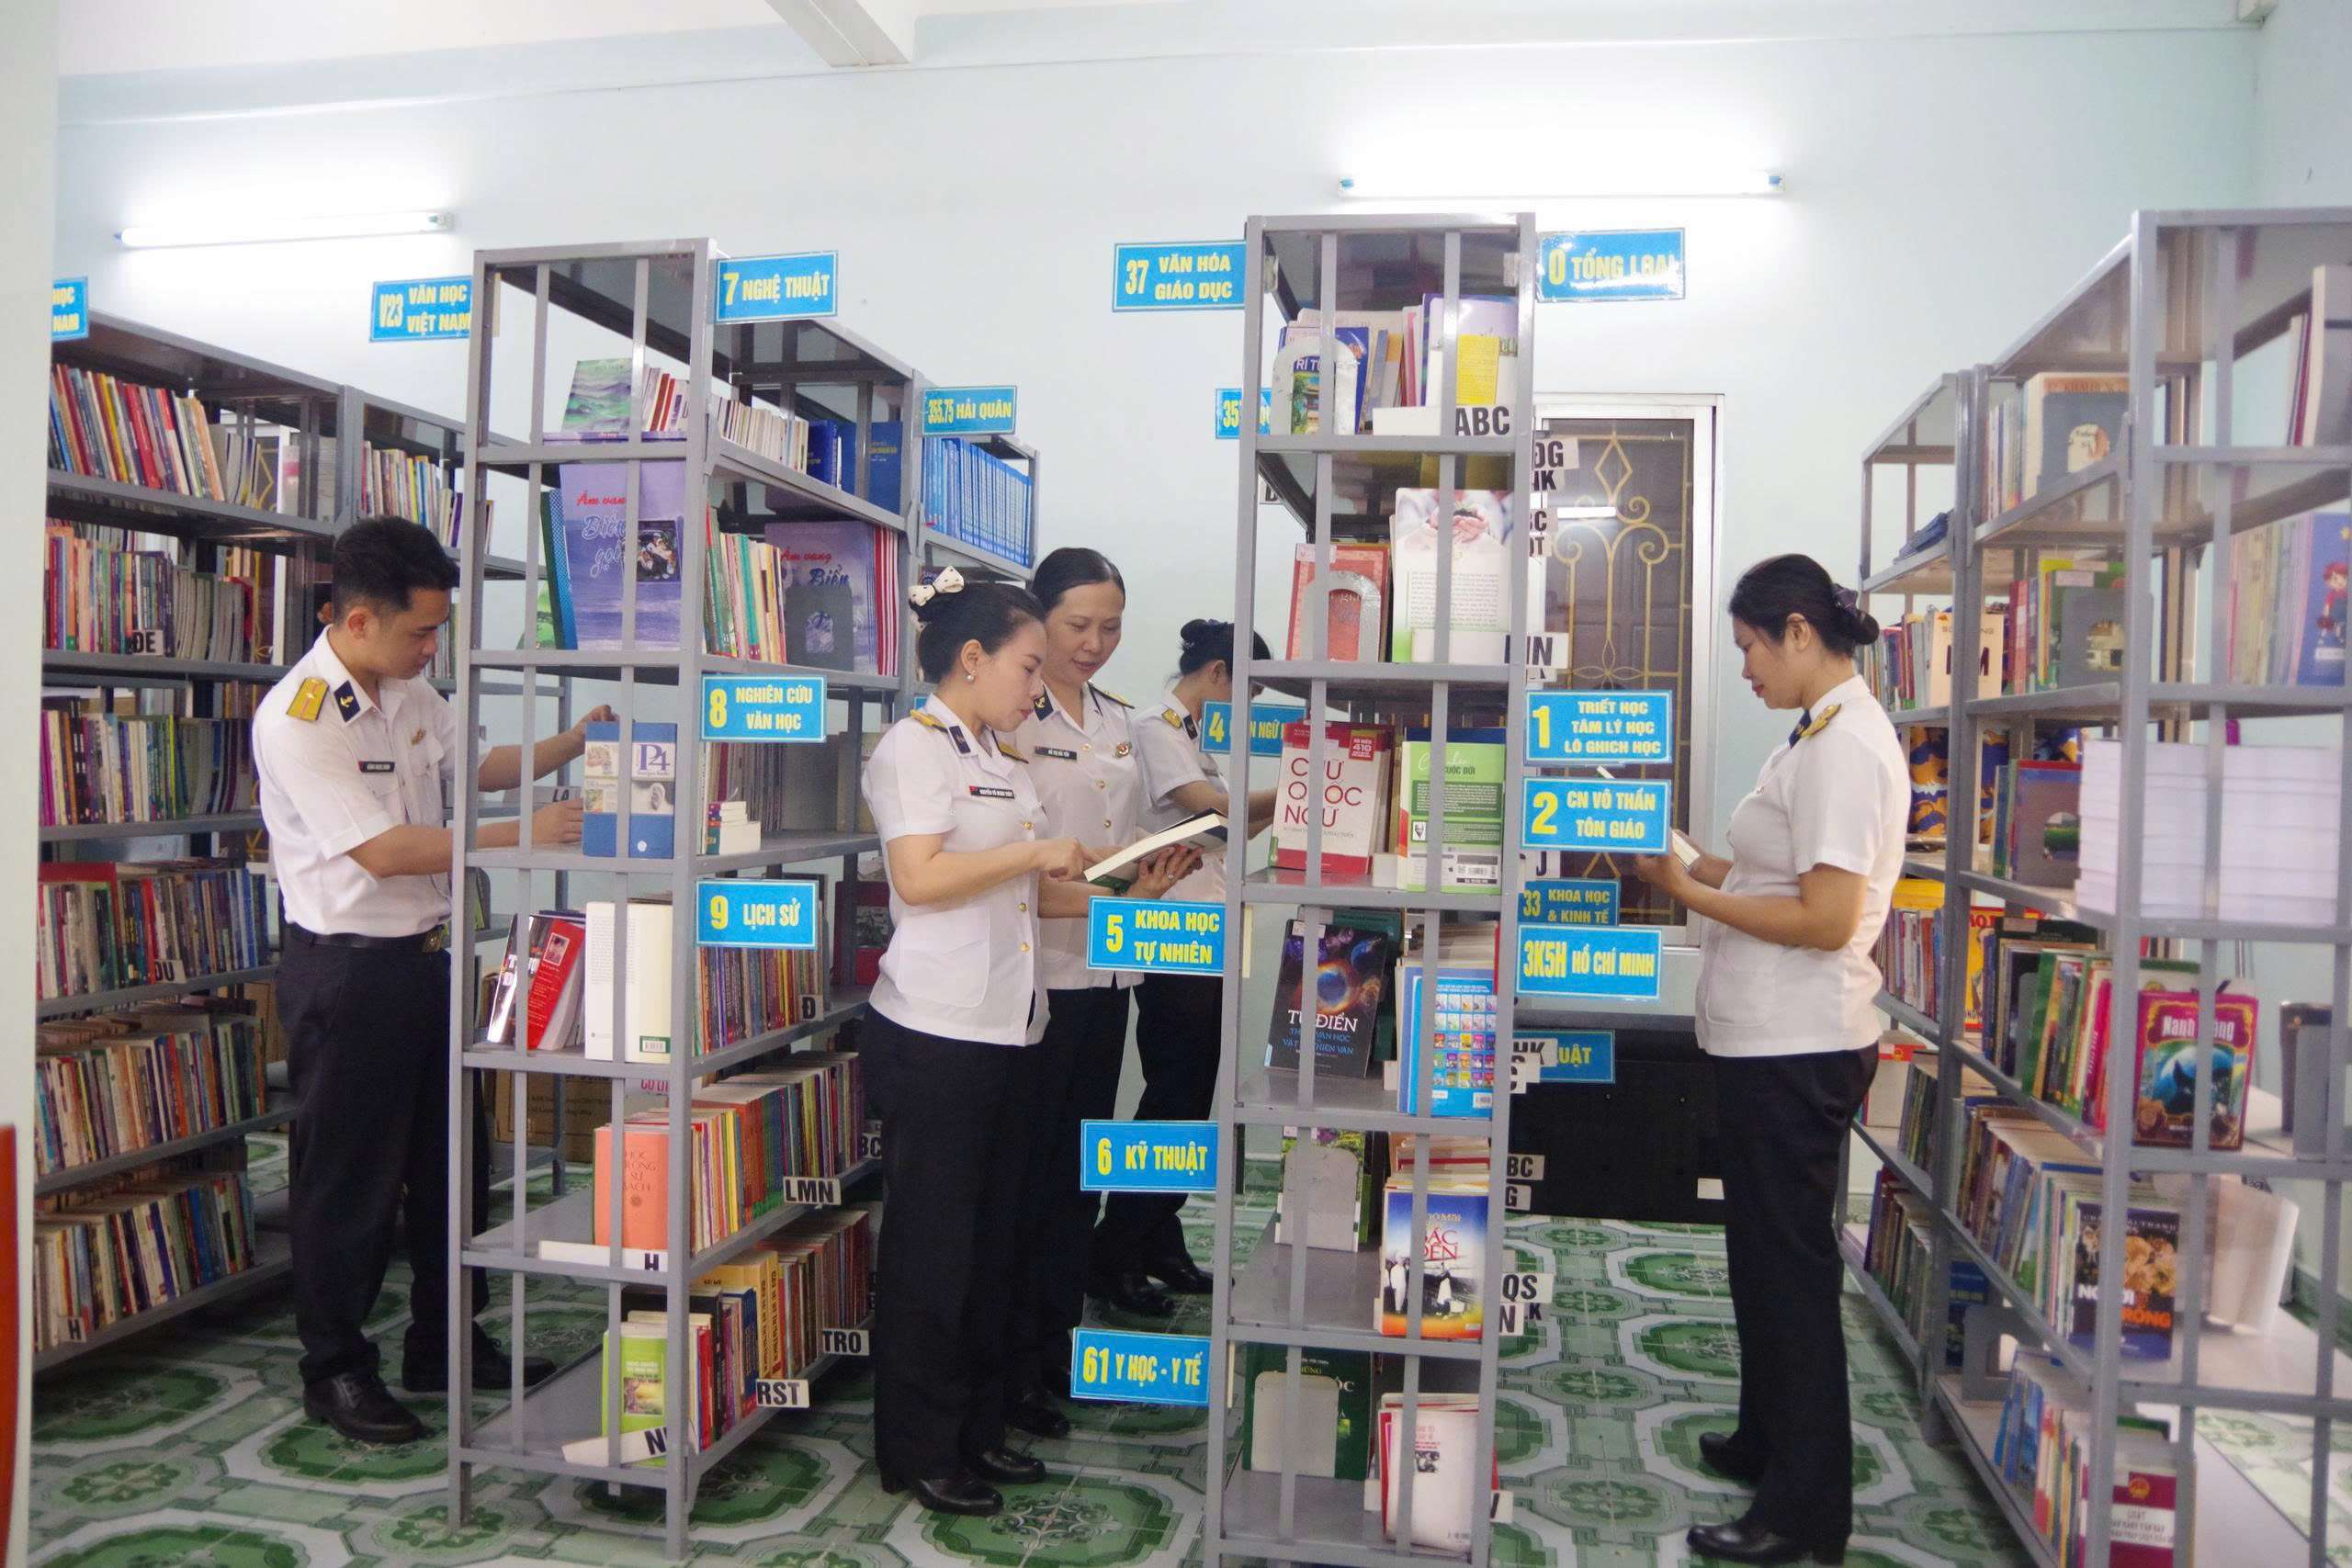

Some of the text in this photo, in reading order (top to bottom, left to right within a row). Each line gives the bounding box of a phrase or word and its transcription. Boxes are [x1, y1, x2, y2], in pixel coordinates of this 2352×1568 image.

[1159, 253, 1231, 273] VĂN HÓA
[1572, 247, 1623, 279] TỔNG
[724, 271, 830, 305] 7 NGHỆ THUẬT
[1125, 260, 1148, 295] 37
[1155, 279, 1232, 301] GIÁO DỤC
[409, 285, 467, 306] VĂN HỌC
[379, 293, 404, 328] V23
[407, 312, 436, 335] VIỆT
[956, 398, 976, 419] HẢI
[979, 399, 1012, 420] QUÂN
[1455, 406, 1510, 436] ABC
[709, 688, 729, 728] 8
[736, 684, 813, 705] NGHIÊN CỨU
[1577, 699, 1649, 717] TRIẾT HỌC
[746, 710, 802, 734] VĂN HỌC
[1208, 711, 1225, 743] 4
[1532, 705, 1551, 749] 1
[1572, 718, 1656, 737] TÂM LÝ HỌC
[1564, 738, 1583, 753] LÔ
[1632, 740, 1662, 757] HỌC
[1566, 791, 1589, 809] CN
[1592, 787, 1611, 809] VÔ
[1532, 792, 1558, 834] 2
[1576, 817, 1645, 839] TÔN GIÁO
[1522, 889, 1542, 917] 33
[1548, 889, 1611, 905] KHOA HỌC
[710, 895, 729, 930] 9
[743, 897, 802, 930] LỊCH SỬ
[1136, 909, 1220, 936] KHOA HỌC
[1547, 908, 1610, 924] & KINH TẾ
[1106, 914, 1125, 953] 5
[1134, 941, 1213, 965] TỰ NHIÊN
[1522, 940, 1567, 977] 3K5H
[1593, 946, 1616, 975] CHÍ
[1618, 952, 1655, 976] MINH
[1097, 1137, 1113, 1175] 6
[1125, 1141, 1208, 1176] KỸ THUẬT
[785, 1179, 835, 1203] LMN
[1502, 1274, 1538, 1302] QS
[822, 1330, 861, 1354] TRO
[1082, 1346, 1110, 1384] 61
[1115, 1353, 1125, 1380] Y
[1127, 1355, 1158, 1387] HỌC
[1171, 1358, 1181, 1384] Y
[1184, 1351, 1204, 1386] TẾ
[757, 1381, 799, 1406] RST
